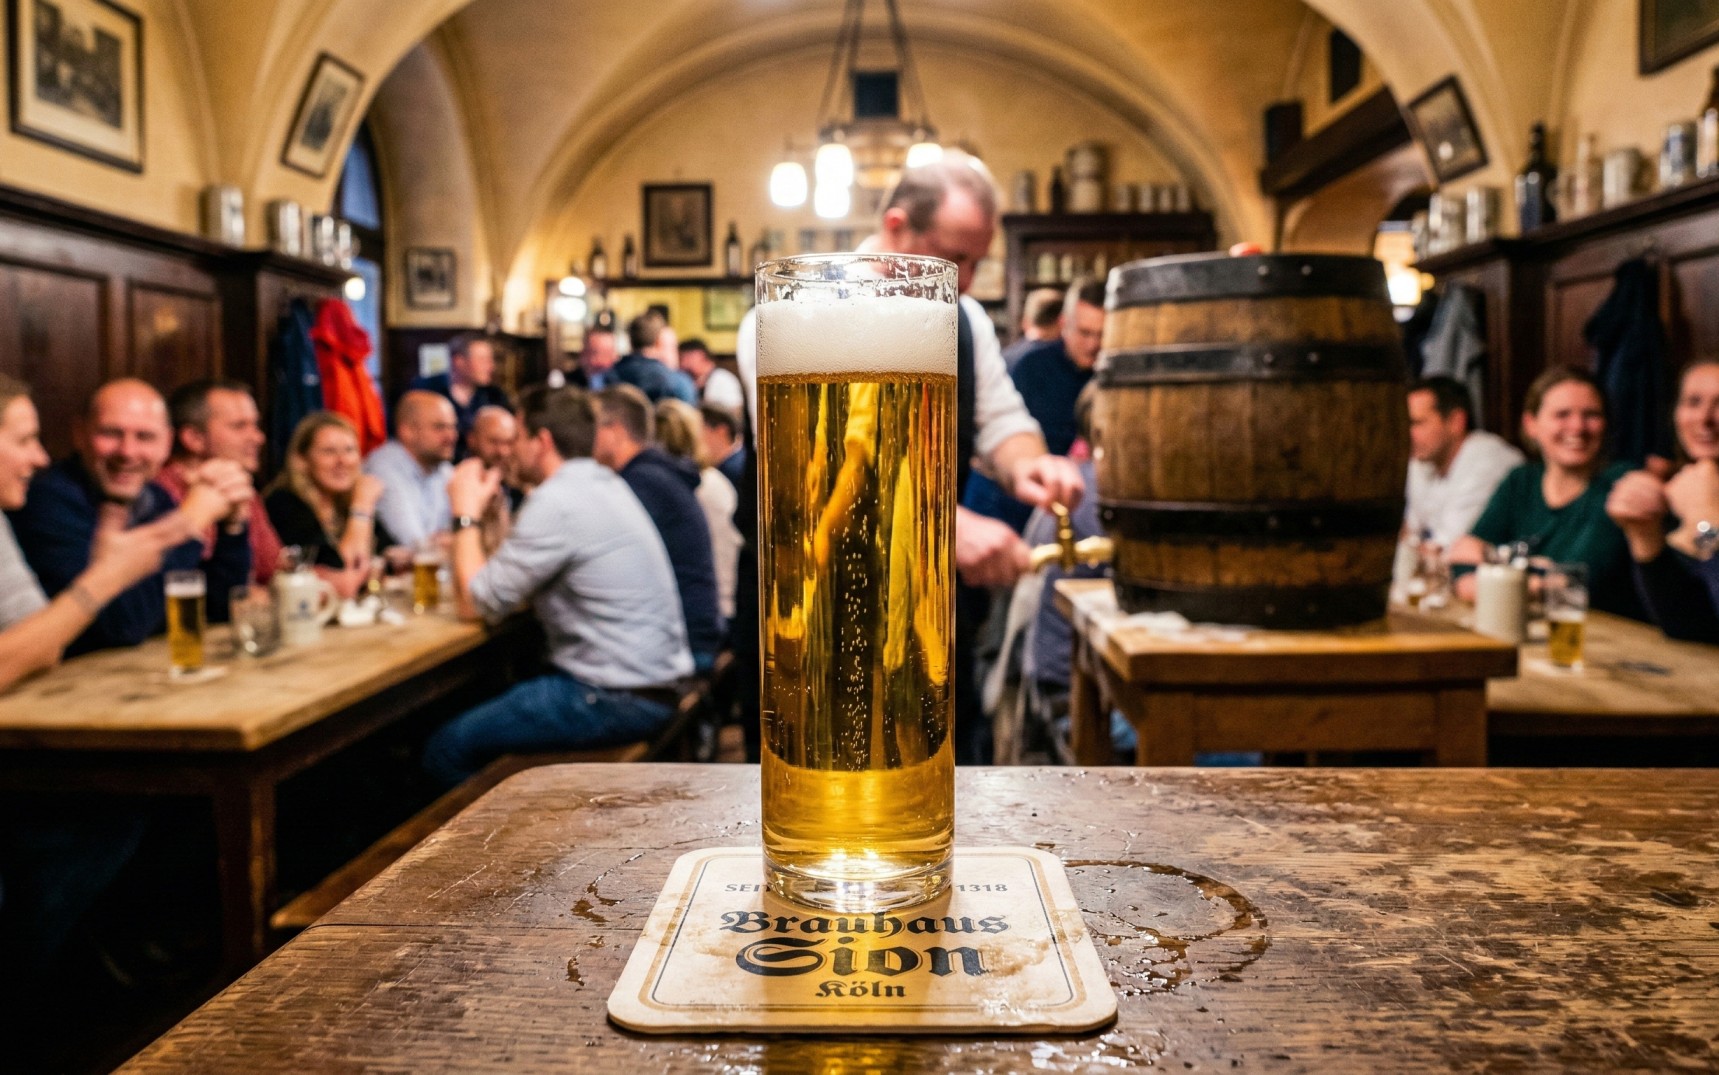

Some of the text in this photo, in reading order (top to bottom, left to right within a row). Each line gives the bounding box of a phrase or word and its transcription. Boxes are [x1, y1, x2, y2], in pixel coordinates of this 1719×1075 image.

[956, 883, 1008, 892] 1318
[719, 910, 1012, 938] Brauhaus
[735, 936, 991, 977] Sion
[815, 979, 906, 998] Köln
